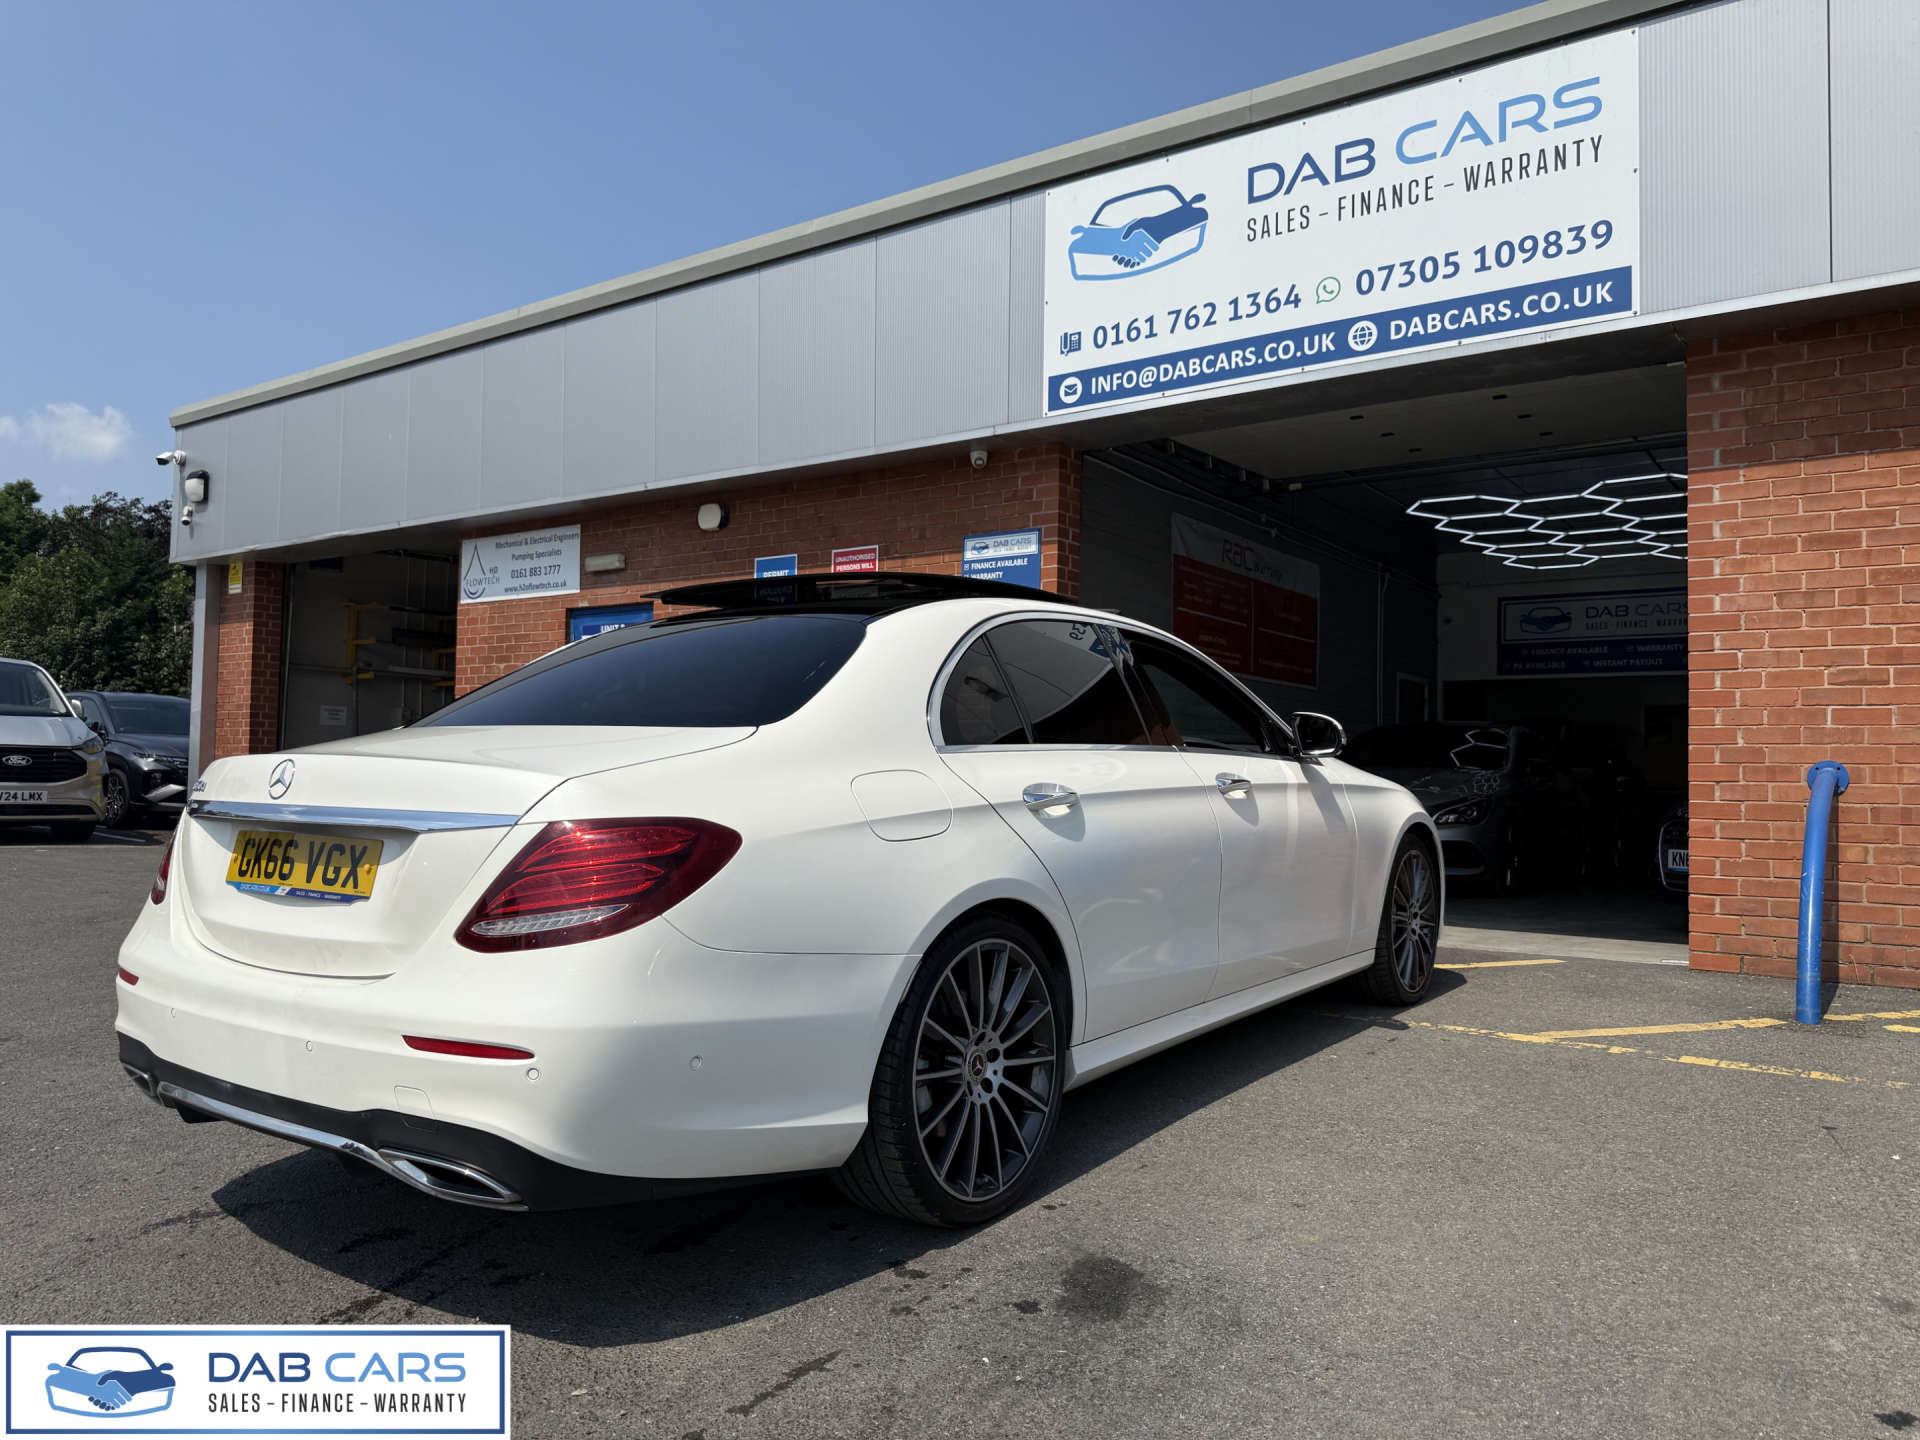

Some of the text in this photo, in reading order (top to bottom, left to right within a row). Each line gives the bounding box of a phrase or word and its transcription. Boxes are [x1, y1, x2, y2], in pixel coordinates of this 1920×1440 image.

[1248, 76, 1603, 204] DAB CARS
[1247, 204, 1310, 242] SALES
[1338, 175, 1434, 221] FINANCE
[1463, 134, 1603, 192] WARRANTY
[1093, 219, 1613, 349] 0161 762 1364 07305 109839
[1091, 281, 1614, 394] INFO@DABCARS.CO.UK DABCARS.CO.UK
[529, 535, 553, 545] Electrical
[554, 532, 579, 543] Engineers
[993, 537, 1032, 547] DAB CARS
[512, 548, 562, 561] Pumping Specialists
[836, 553, 875, 562] UNAUTHORISED
[836, 563, 860, 572] PERSONS
[971, 558, 1028, 570] FINANCE AVAILABLE
[511, 564, 561, 579] 0161 883 1777
[465, 576, 500, 587] FLOWTECH
[1585, 604, 1629, 619] DAB
[238, 838, 368, 890] GK66 VGX
